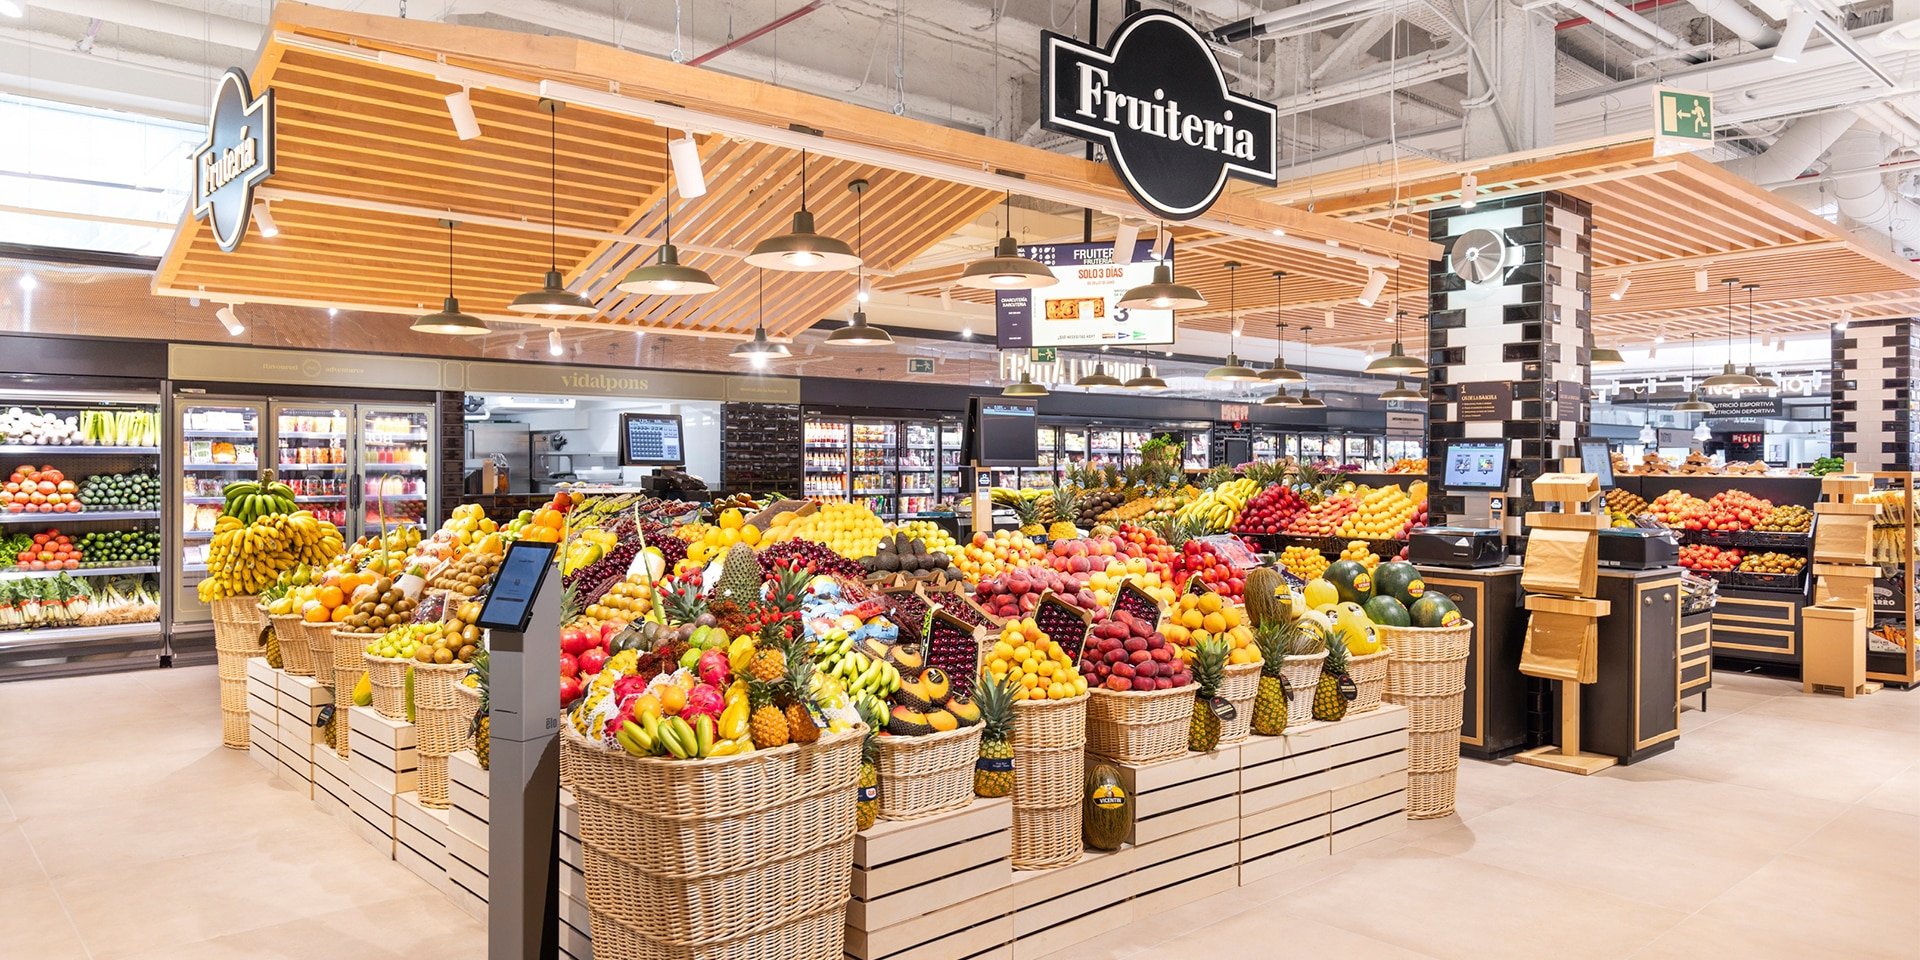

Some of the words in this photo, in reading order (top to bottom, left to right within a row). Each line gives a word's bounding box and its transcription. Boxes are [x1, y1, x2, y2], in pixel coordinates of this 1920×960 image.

[1076, 62, 1256, 161] Fruiteria
[203, 125, 257, 197] Frutería
[1073, 248, 1115, 260] FRUITER
[1078, 269, 1098, 279] SOLO
[1098, 269, 1104, 278] 3
[561, 372, 649, 392] vidalpons
[1461, 384, 1467, 394] 1
